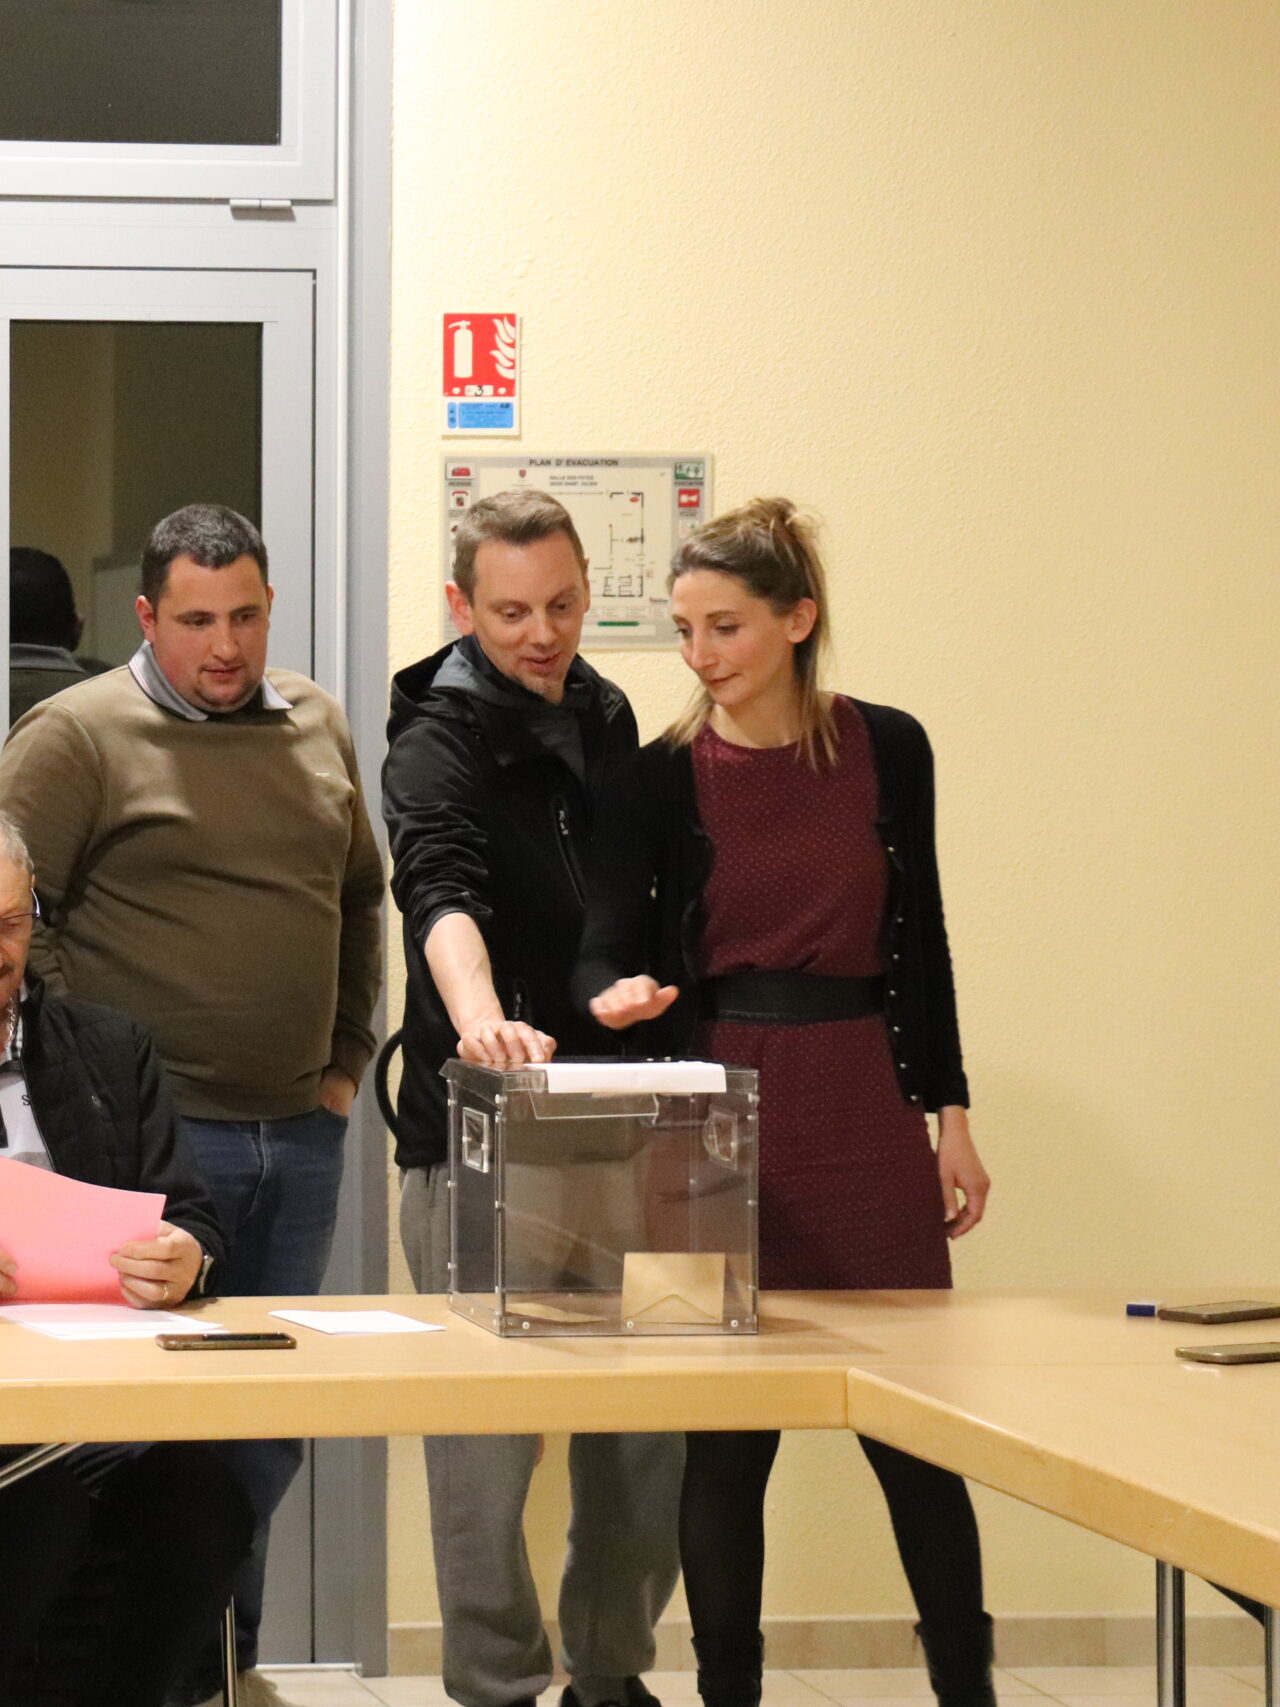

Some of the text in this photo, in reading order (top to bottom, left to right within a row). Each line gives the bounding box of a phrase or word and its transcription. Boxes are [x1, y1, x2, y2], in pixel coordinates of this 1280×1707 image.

[474, 384, 484, 397] 3
[529, 458, 551, 466] PLAN
[566, 458, 619, 466] EVACUATION
